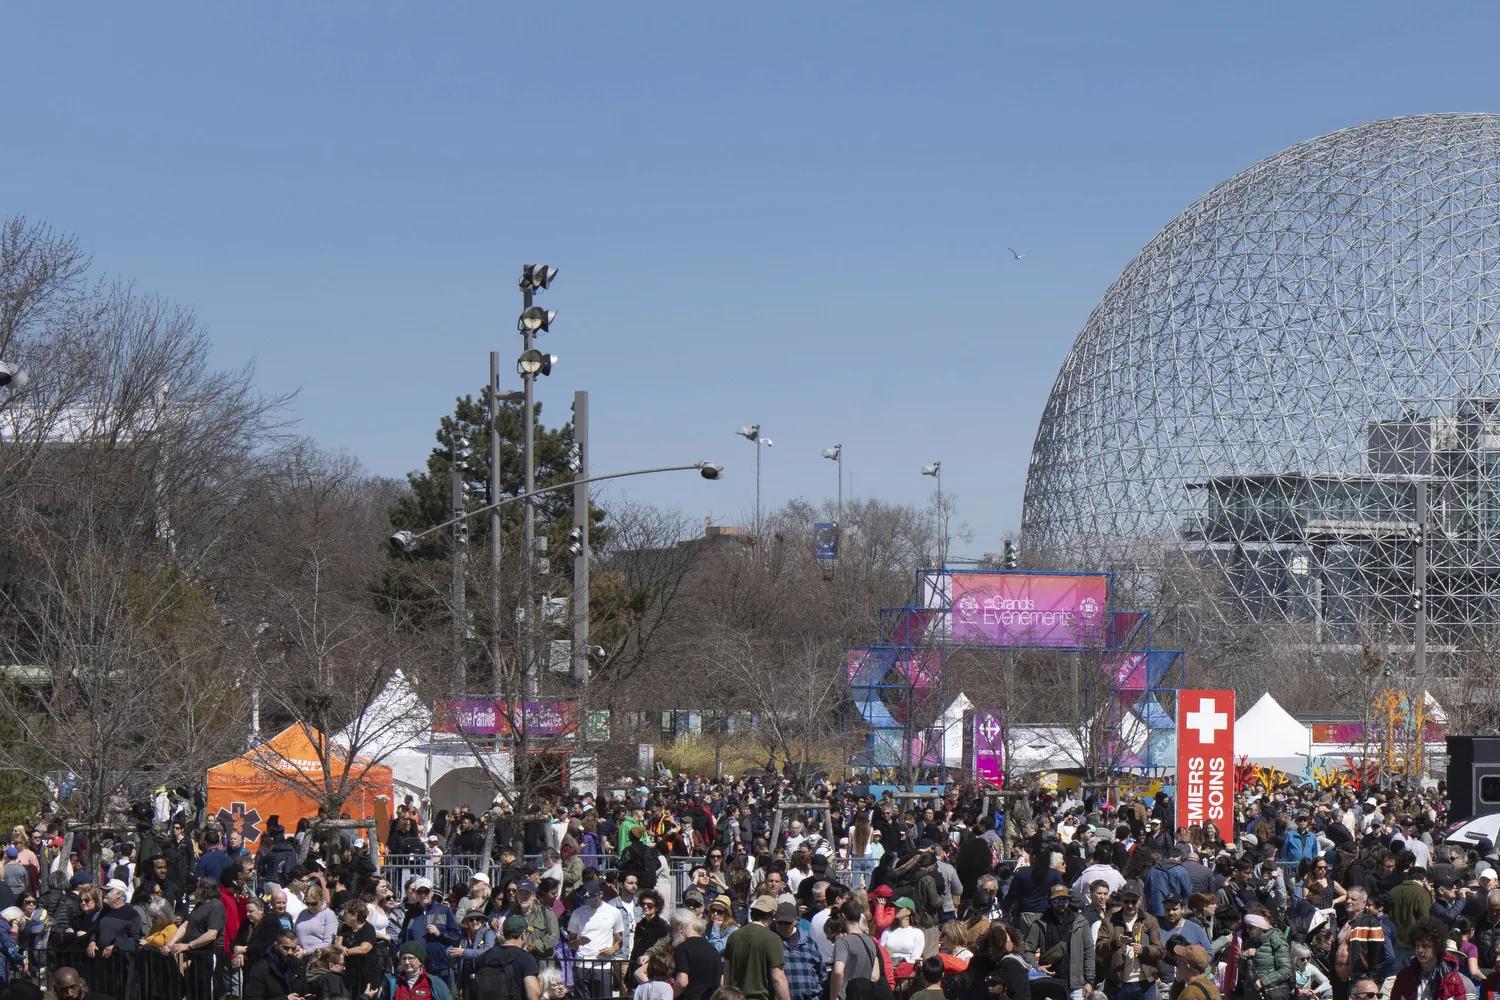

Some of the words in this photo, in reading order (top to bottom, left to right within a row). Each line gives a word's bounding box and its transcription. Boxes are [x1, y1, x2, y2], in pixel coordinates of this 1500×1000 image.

[992, 595, 1035, 611] Grands
[1187, 756, 1204, 830] EMIERS
[1208, 756, 1225, 820] SOINS
